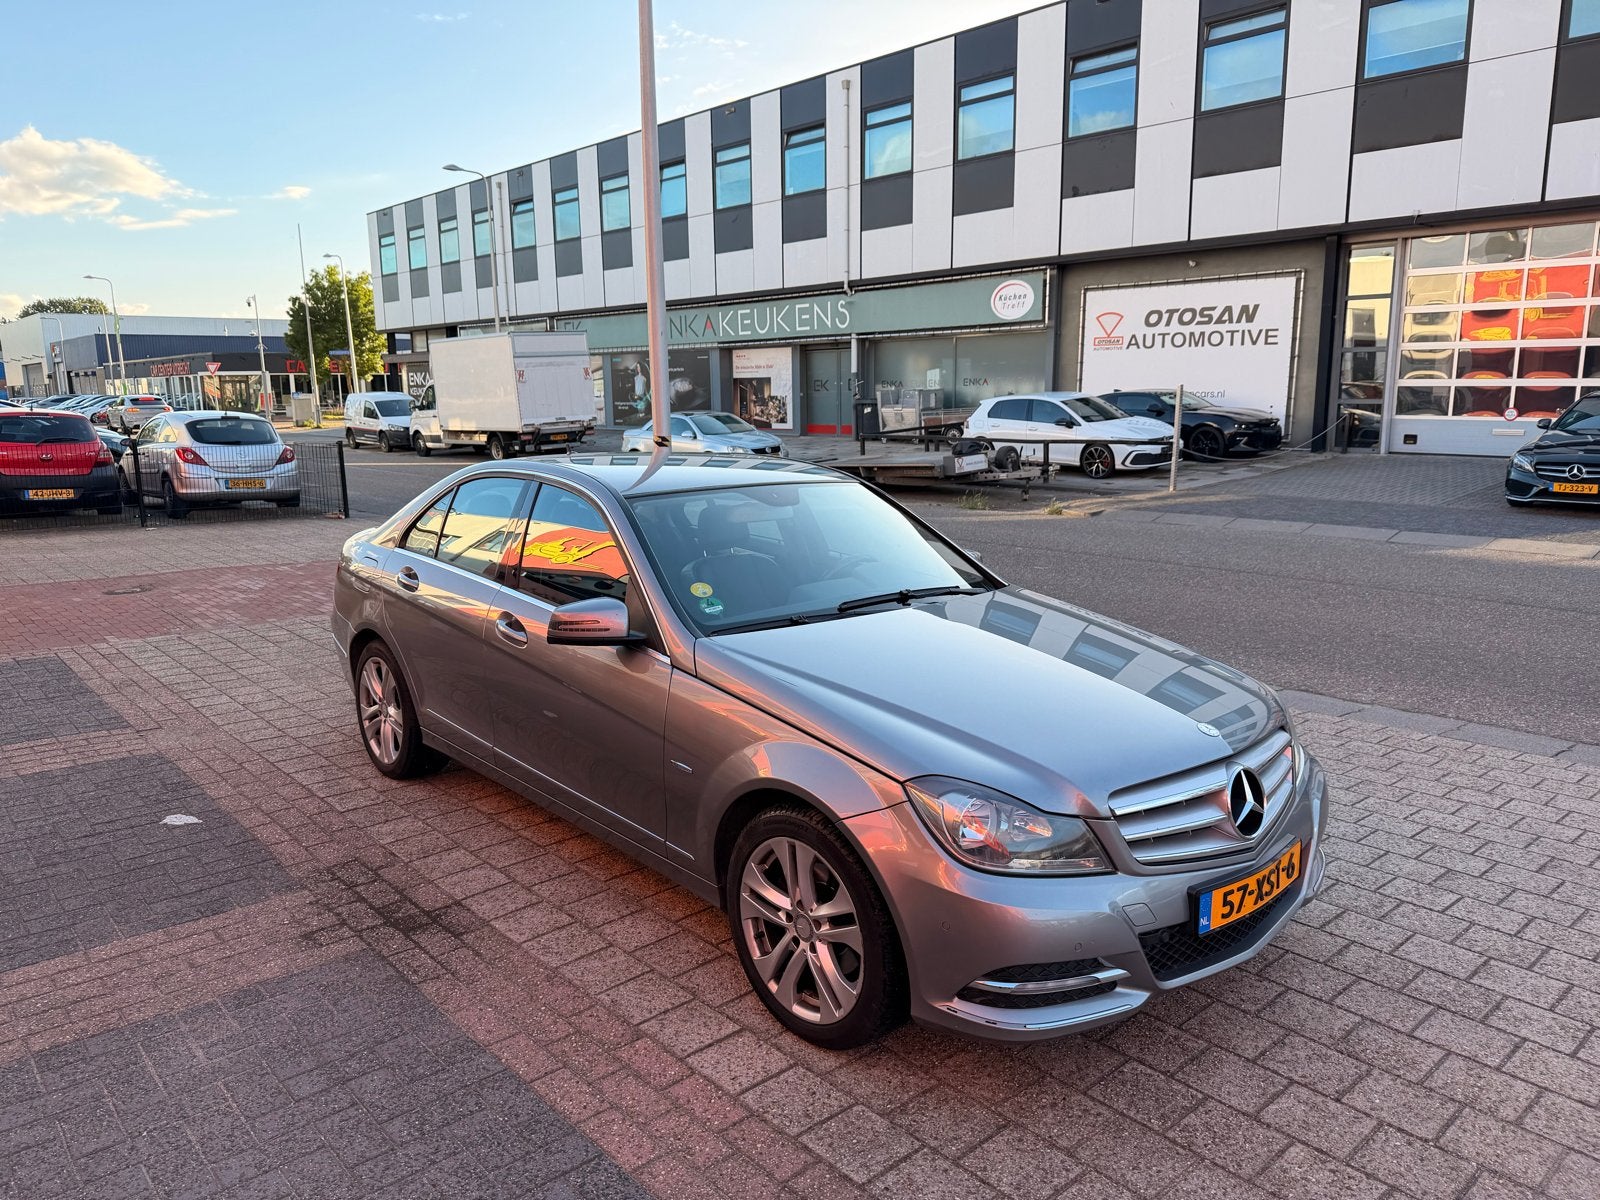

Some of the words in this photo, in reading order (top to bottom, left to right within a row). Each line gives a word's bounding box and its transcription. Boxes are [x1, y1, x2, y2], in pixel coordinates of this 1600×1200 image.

[1144, 304, 1260, 328] OTOSAN
[669, 313, 717, 339] NKA
[1126, 328, 1279, 350] AUTOMOTIVE
[408, 372, 431, 385] ENKA
[881, 379, 904, 389] ENKA
[963, 377, 989, 387] ENKA
[813, 379, 829, 391] EK
[1557, 483, 1594, 492] TJ-323-V
[1220, 852, 1296, 920] 57-XST-6
[1200, 918, 1209, 927] NL
